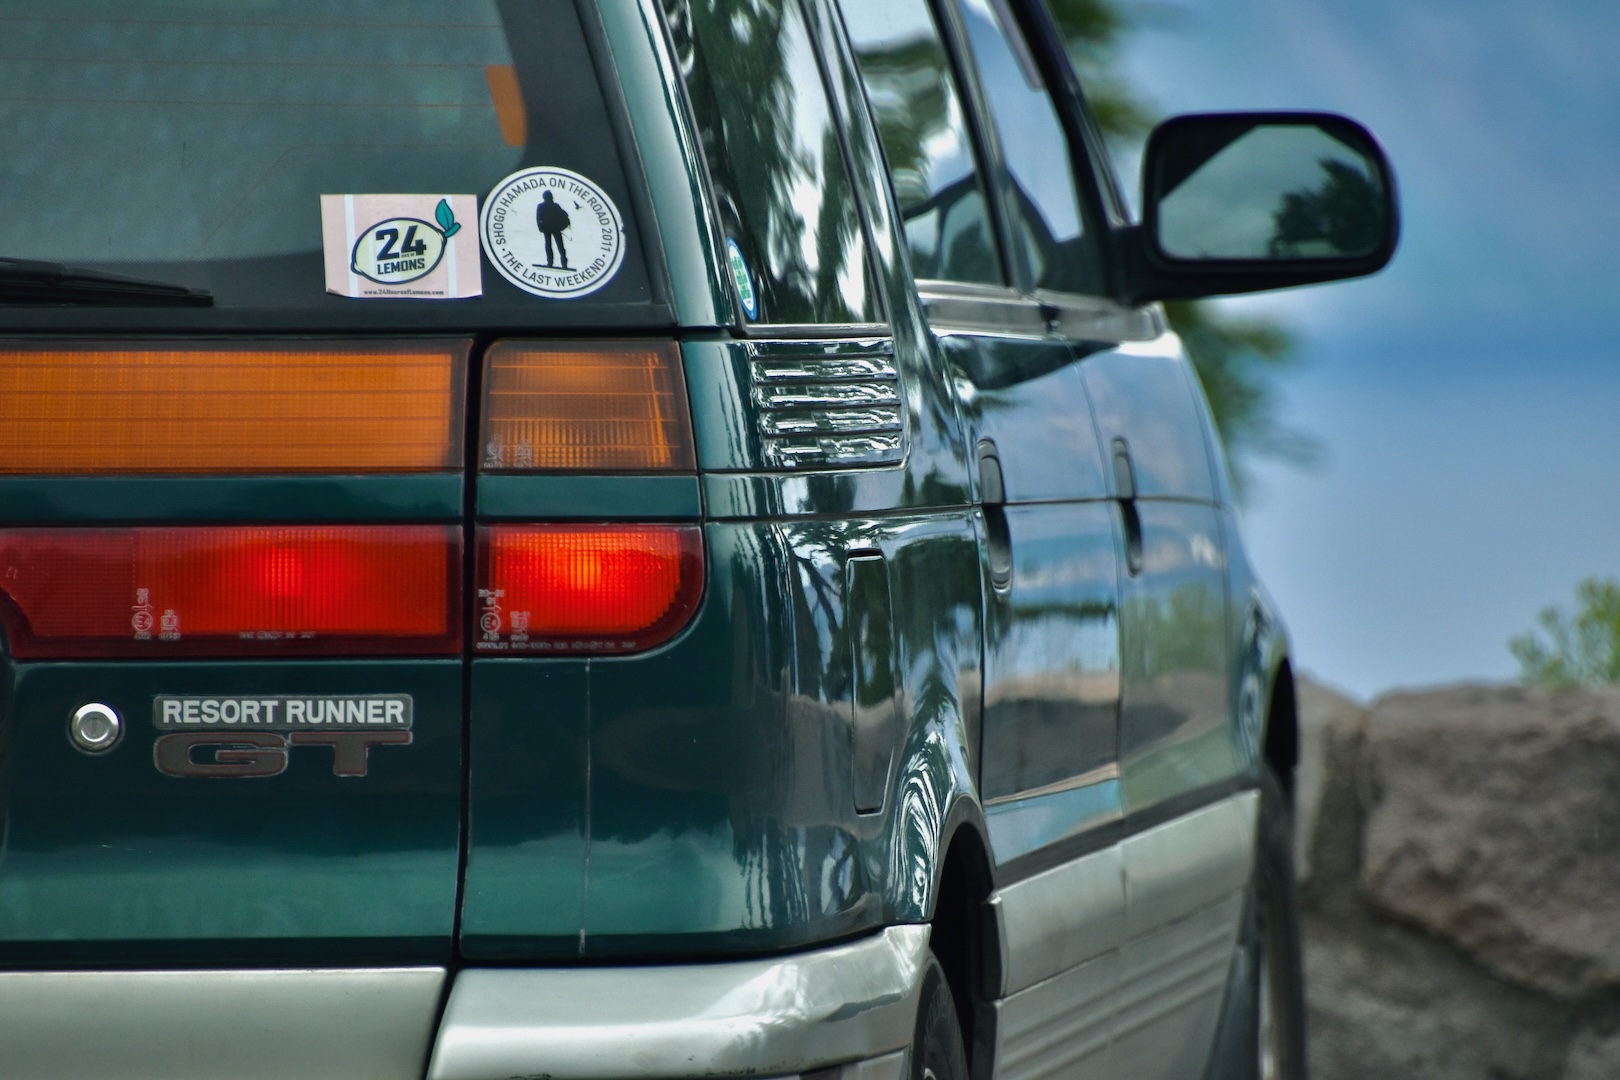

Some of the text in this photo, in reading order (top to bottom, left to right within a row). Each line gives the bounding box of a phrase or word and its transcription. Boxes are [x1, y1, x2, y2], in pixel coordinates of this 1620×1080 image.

[493, 177, 613, 253] SHOGO HAMADA ON THE ROAD 2011
[375, 225, 427, 261] 24
[377, 258, 426, 275] LEMONS
[502, 250, 606, 287] THE LAST WEEKEND
[162, 700, 405, 724] RESORT RUNNER
[153, 731, 413, 778] GT
